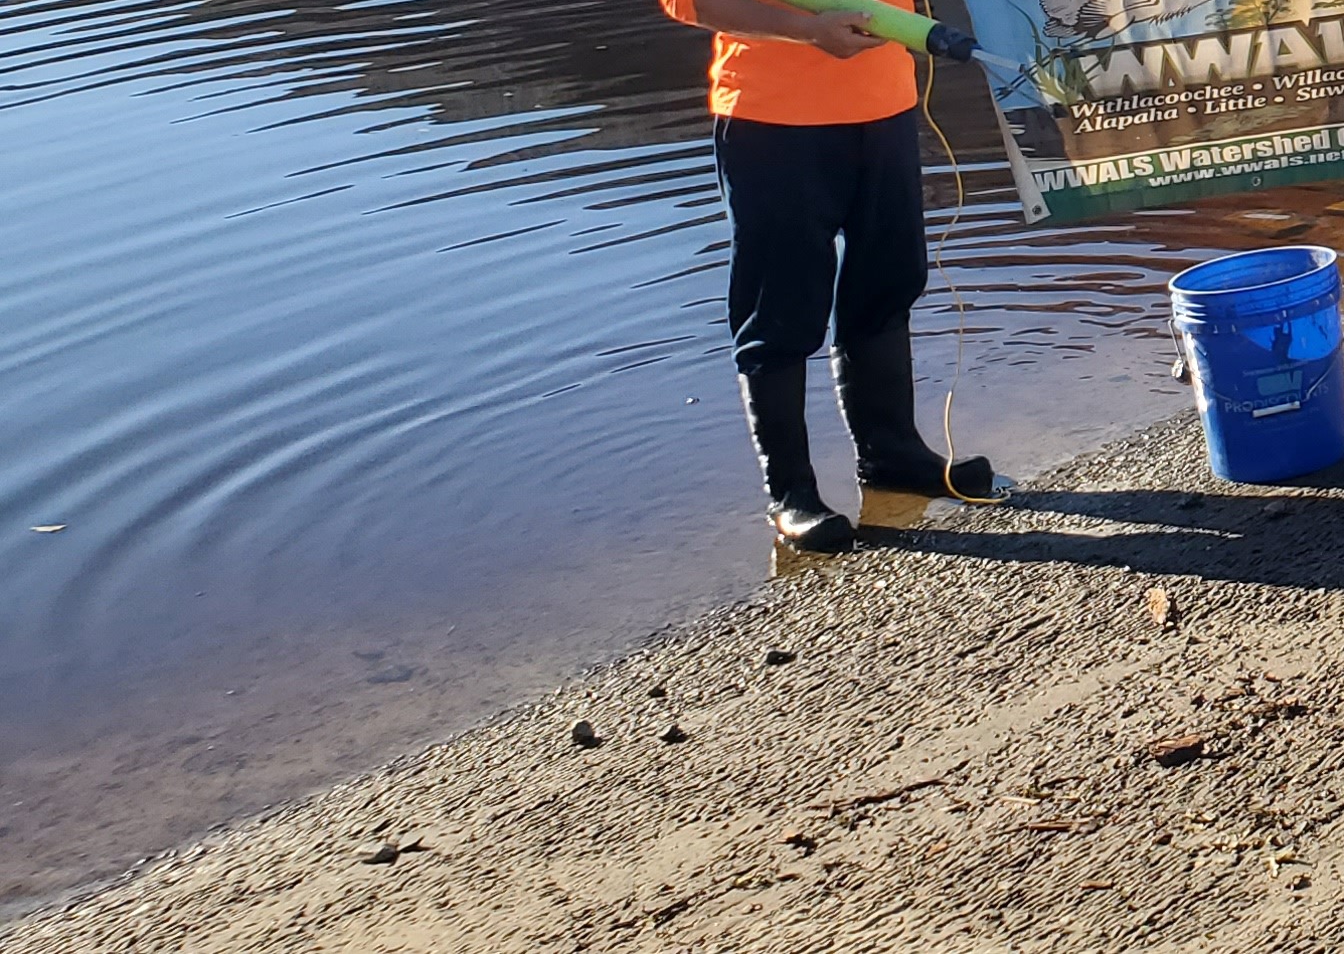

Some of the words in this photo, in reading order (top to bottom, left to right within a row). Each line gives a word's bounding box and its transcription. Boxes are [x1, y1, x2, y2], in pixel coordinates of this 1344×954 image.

[1071, 82, 1244, 119] Withlacoochee
[1073, 105, 1179, 135] Alapaha
[1204, 96, 1267, 115] Little
[1034, 155, 1155, 193] WWALS
[1159, 129, 1331, 173] Watershed
